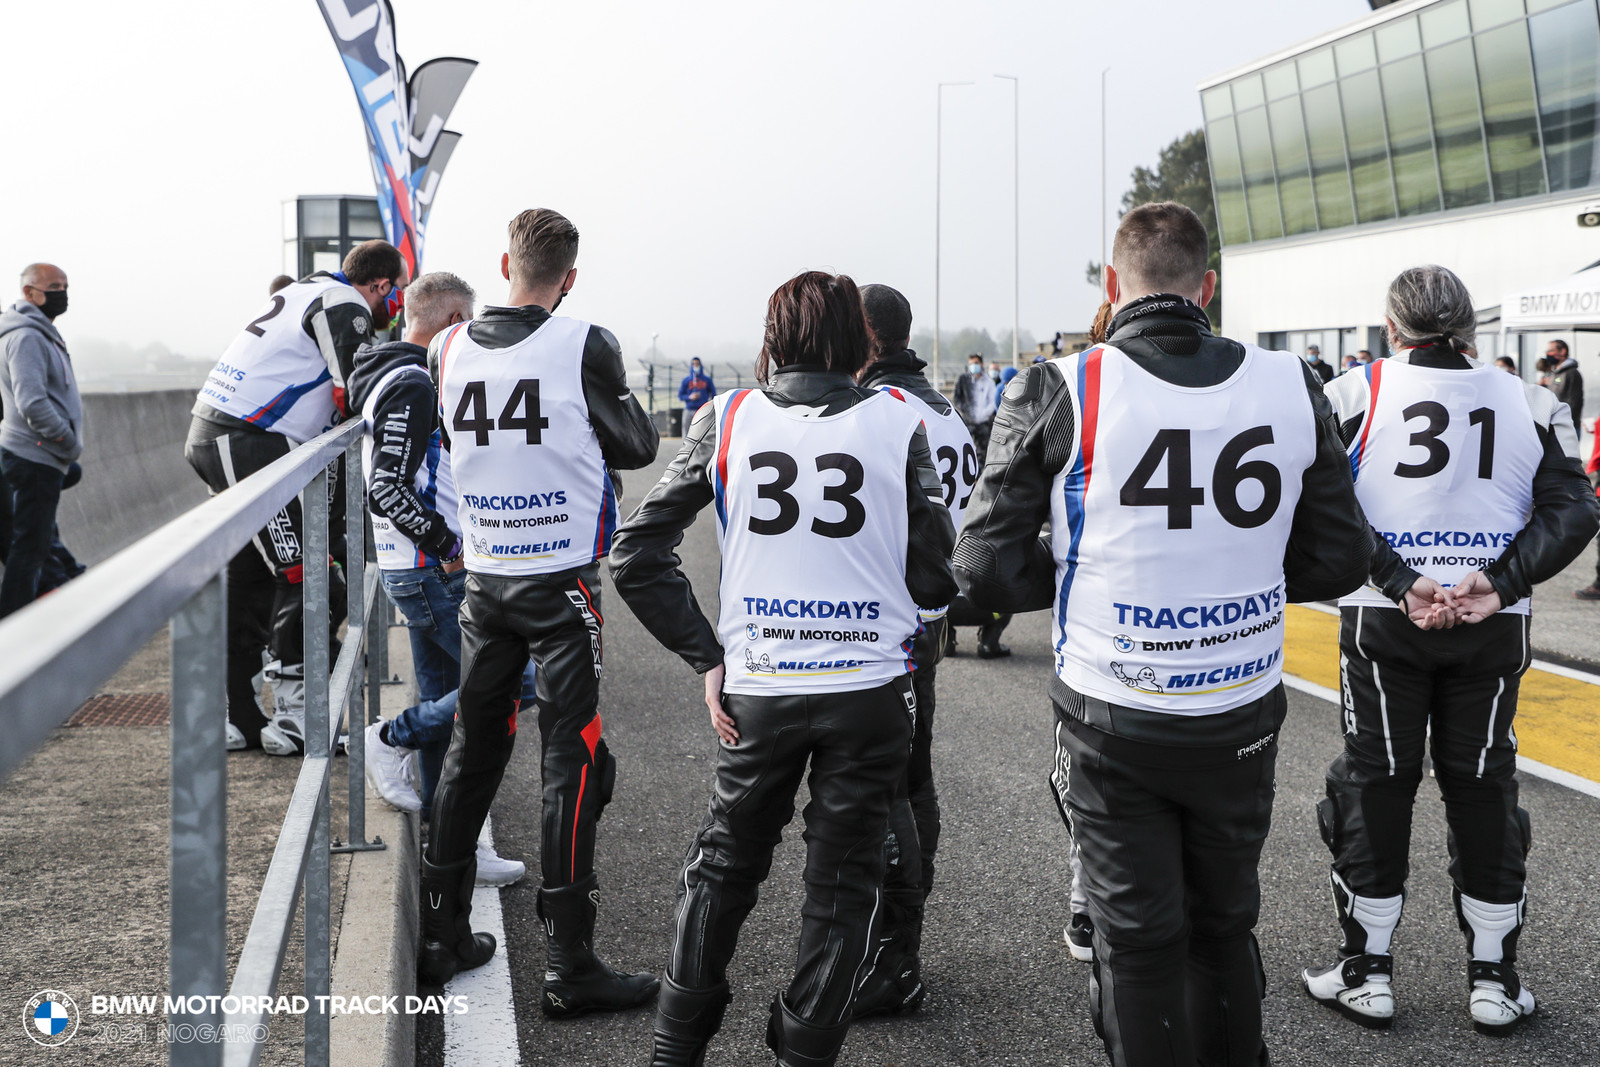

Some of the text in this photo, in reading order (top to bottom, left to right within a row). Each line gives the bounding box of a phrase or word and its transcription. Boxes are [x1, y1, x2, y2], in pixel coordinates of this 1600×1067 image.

[245, 295, 286, 338] 2
[1520, 294, 1560, 313] BMW
[452, 378, 549, 447] 44
[1393, 400, 1495, 480] 31
[748, 451, 866, 538] 33
[936, 443, 977, 510] 39
[1119, 425, 1282, 530] 46
[463, 490, 567, 510] TRACKDAYS
[480, 514, 569, 528] BMW MOTORRAD
[491, 539, 571, 554] MICHELIN
[1404, 556, 1496, 567] MW MOTORR
[743, 597, 880, 620] TRACKDAYS
[1113, 585, 1281, 630] TRACKDAYS
[763, 628, 879, 642] BMW MOTORRAD
[1142, 611, 1282, 652] BMW MOTORRAD
[778, 659, 883, 670] MICHEL
[1166, 647, 1281, 688] MICHELIN
